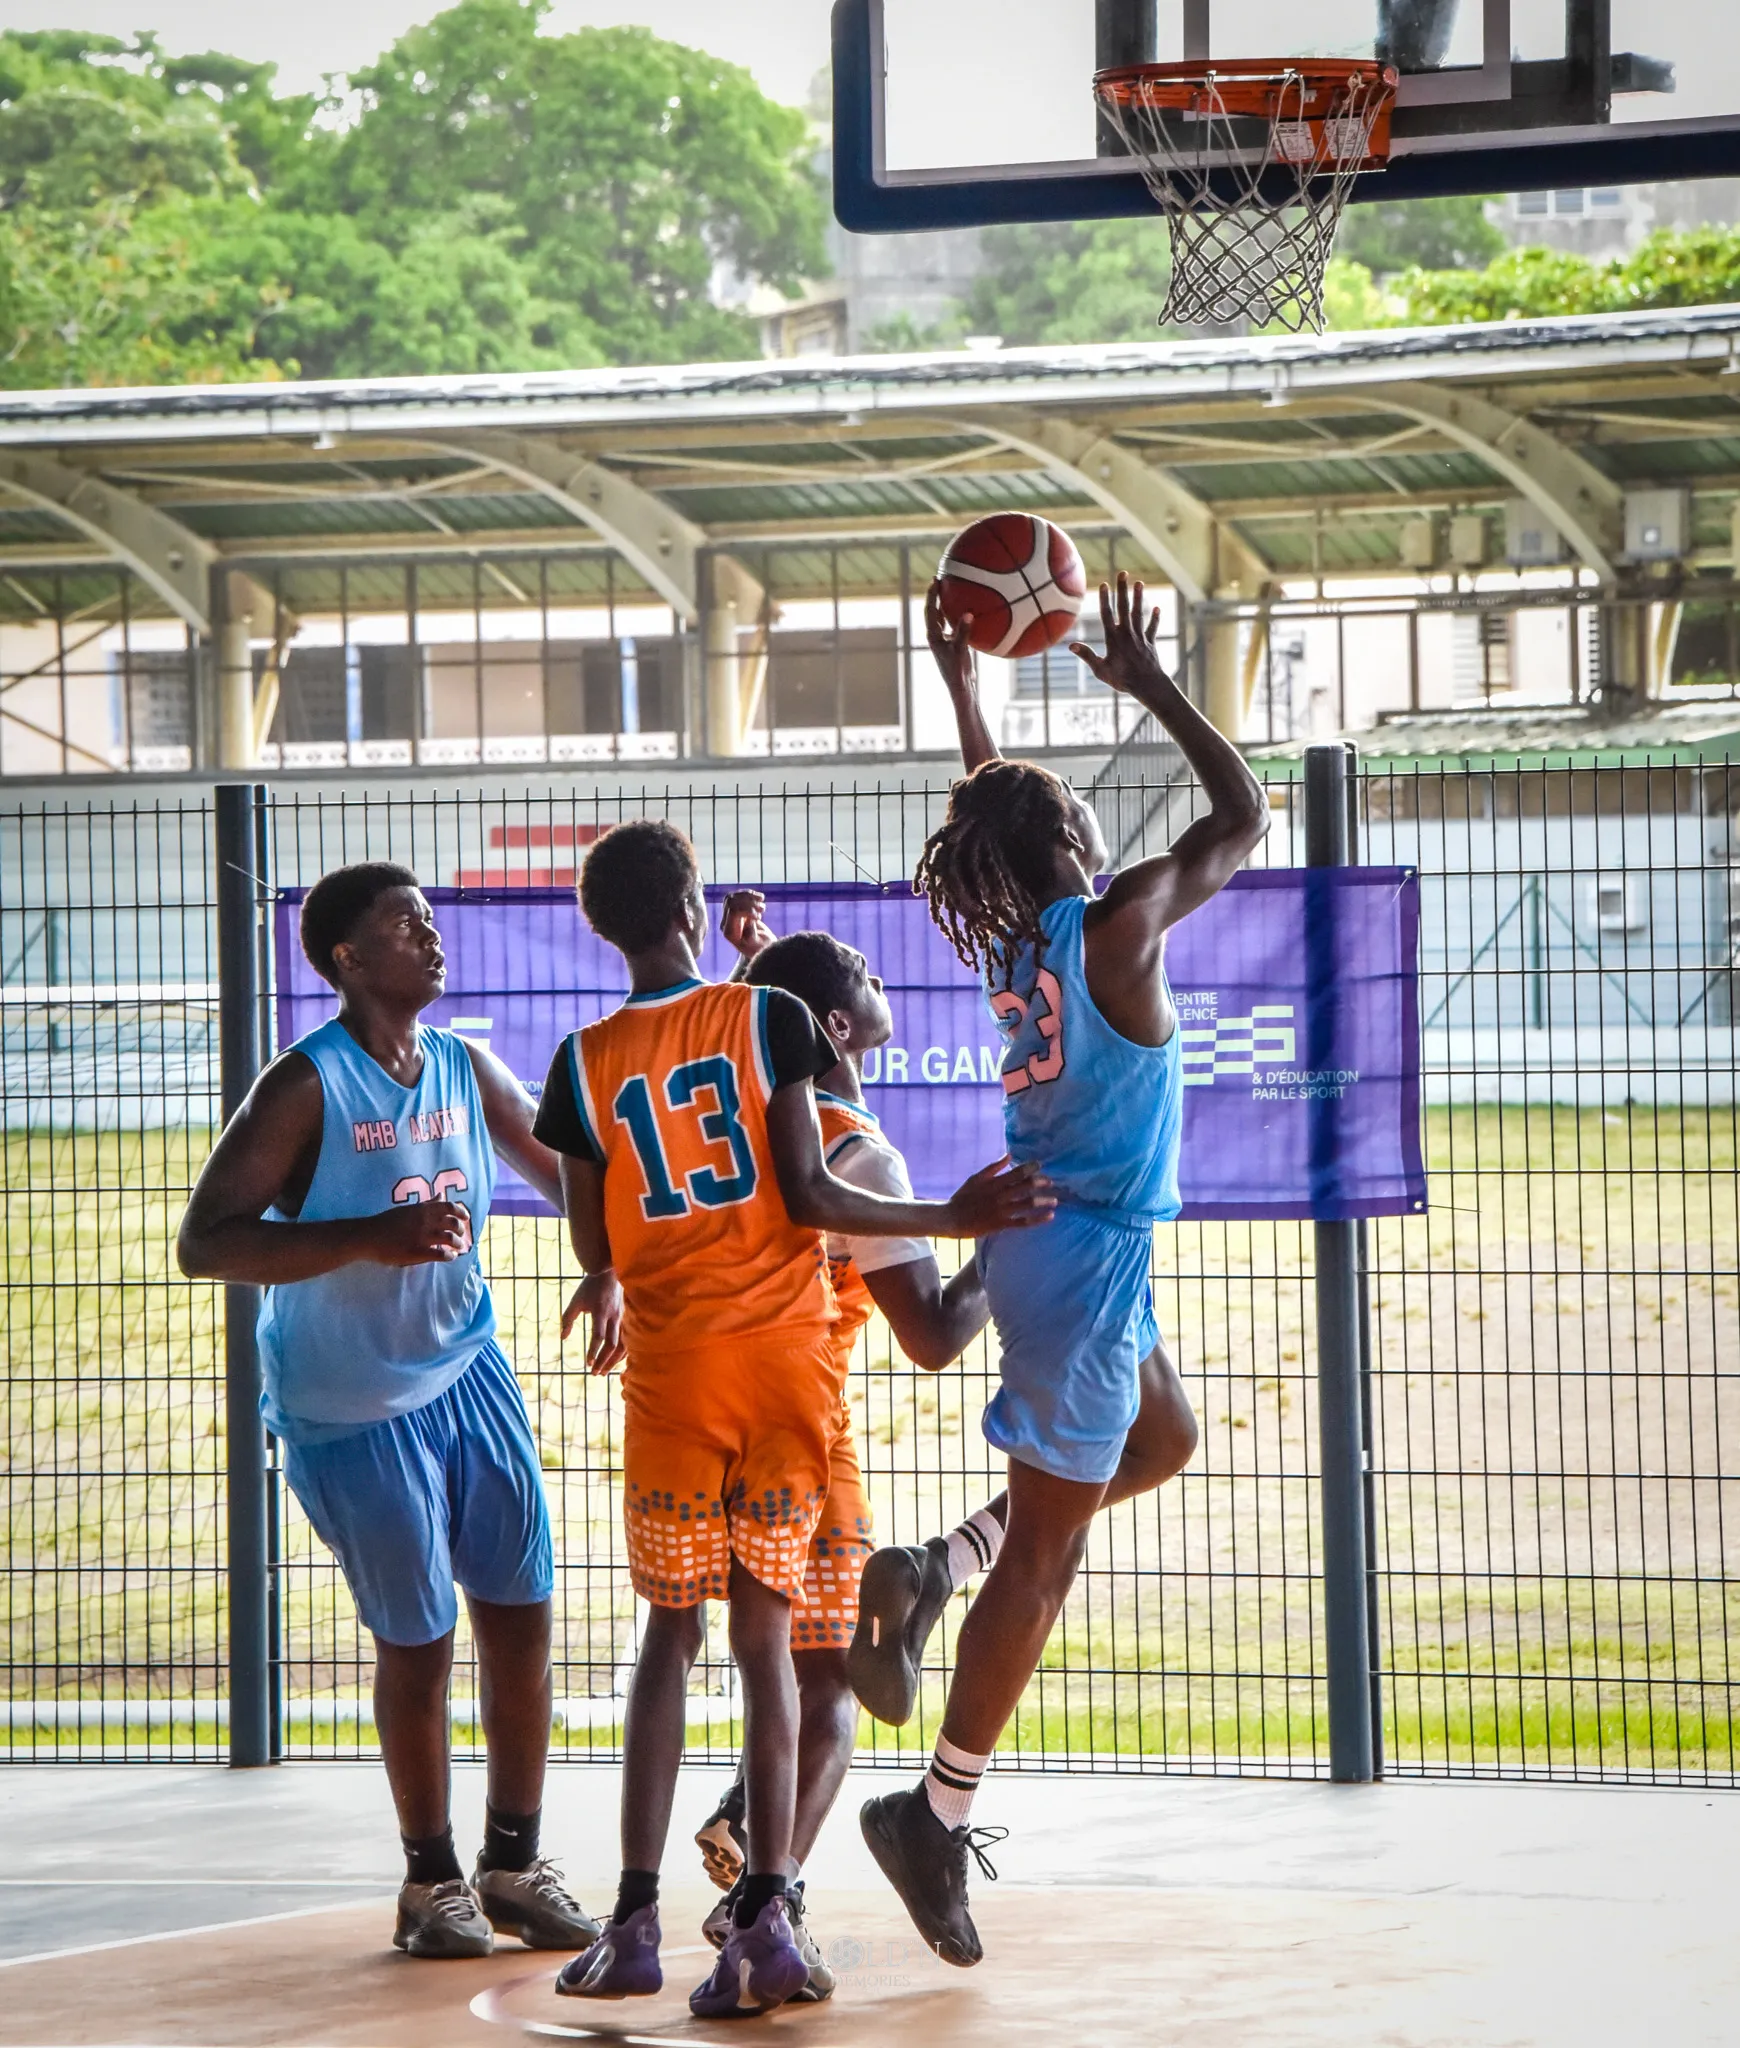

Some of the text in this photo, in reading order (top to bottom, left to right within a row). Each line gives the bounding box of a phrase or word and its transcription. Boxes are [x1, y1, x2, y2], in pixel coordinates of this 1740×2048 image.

[1171, 992, 1219, 1005] ENTRE
[1177, 1007, 1218, 1021] LENCE
[990, 967, 1066, 1096] 23
[861, 1046, 1005, 1084] UR GAM
[1252, 1068, 1359, 1084] & D'ÉDUCATION
[1252, 1086, 1346, 1100] PAR LE SPORT
[353, 1120, 397, 1152] MHB
[612, 1052, 759, 1222] 13
